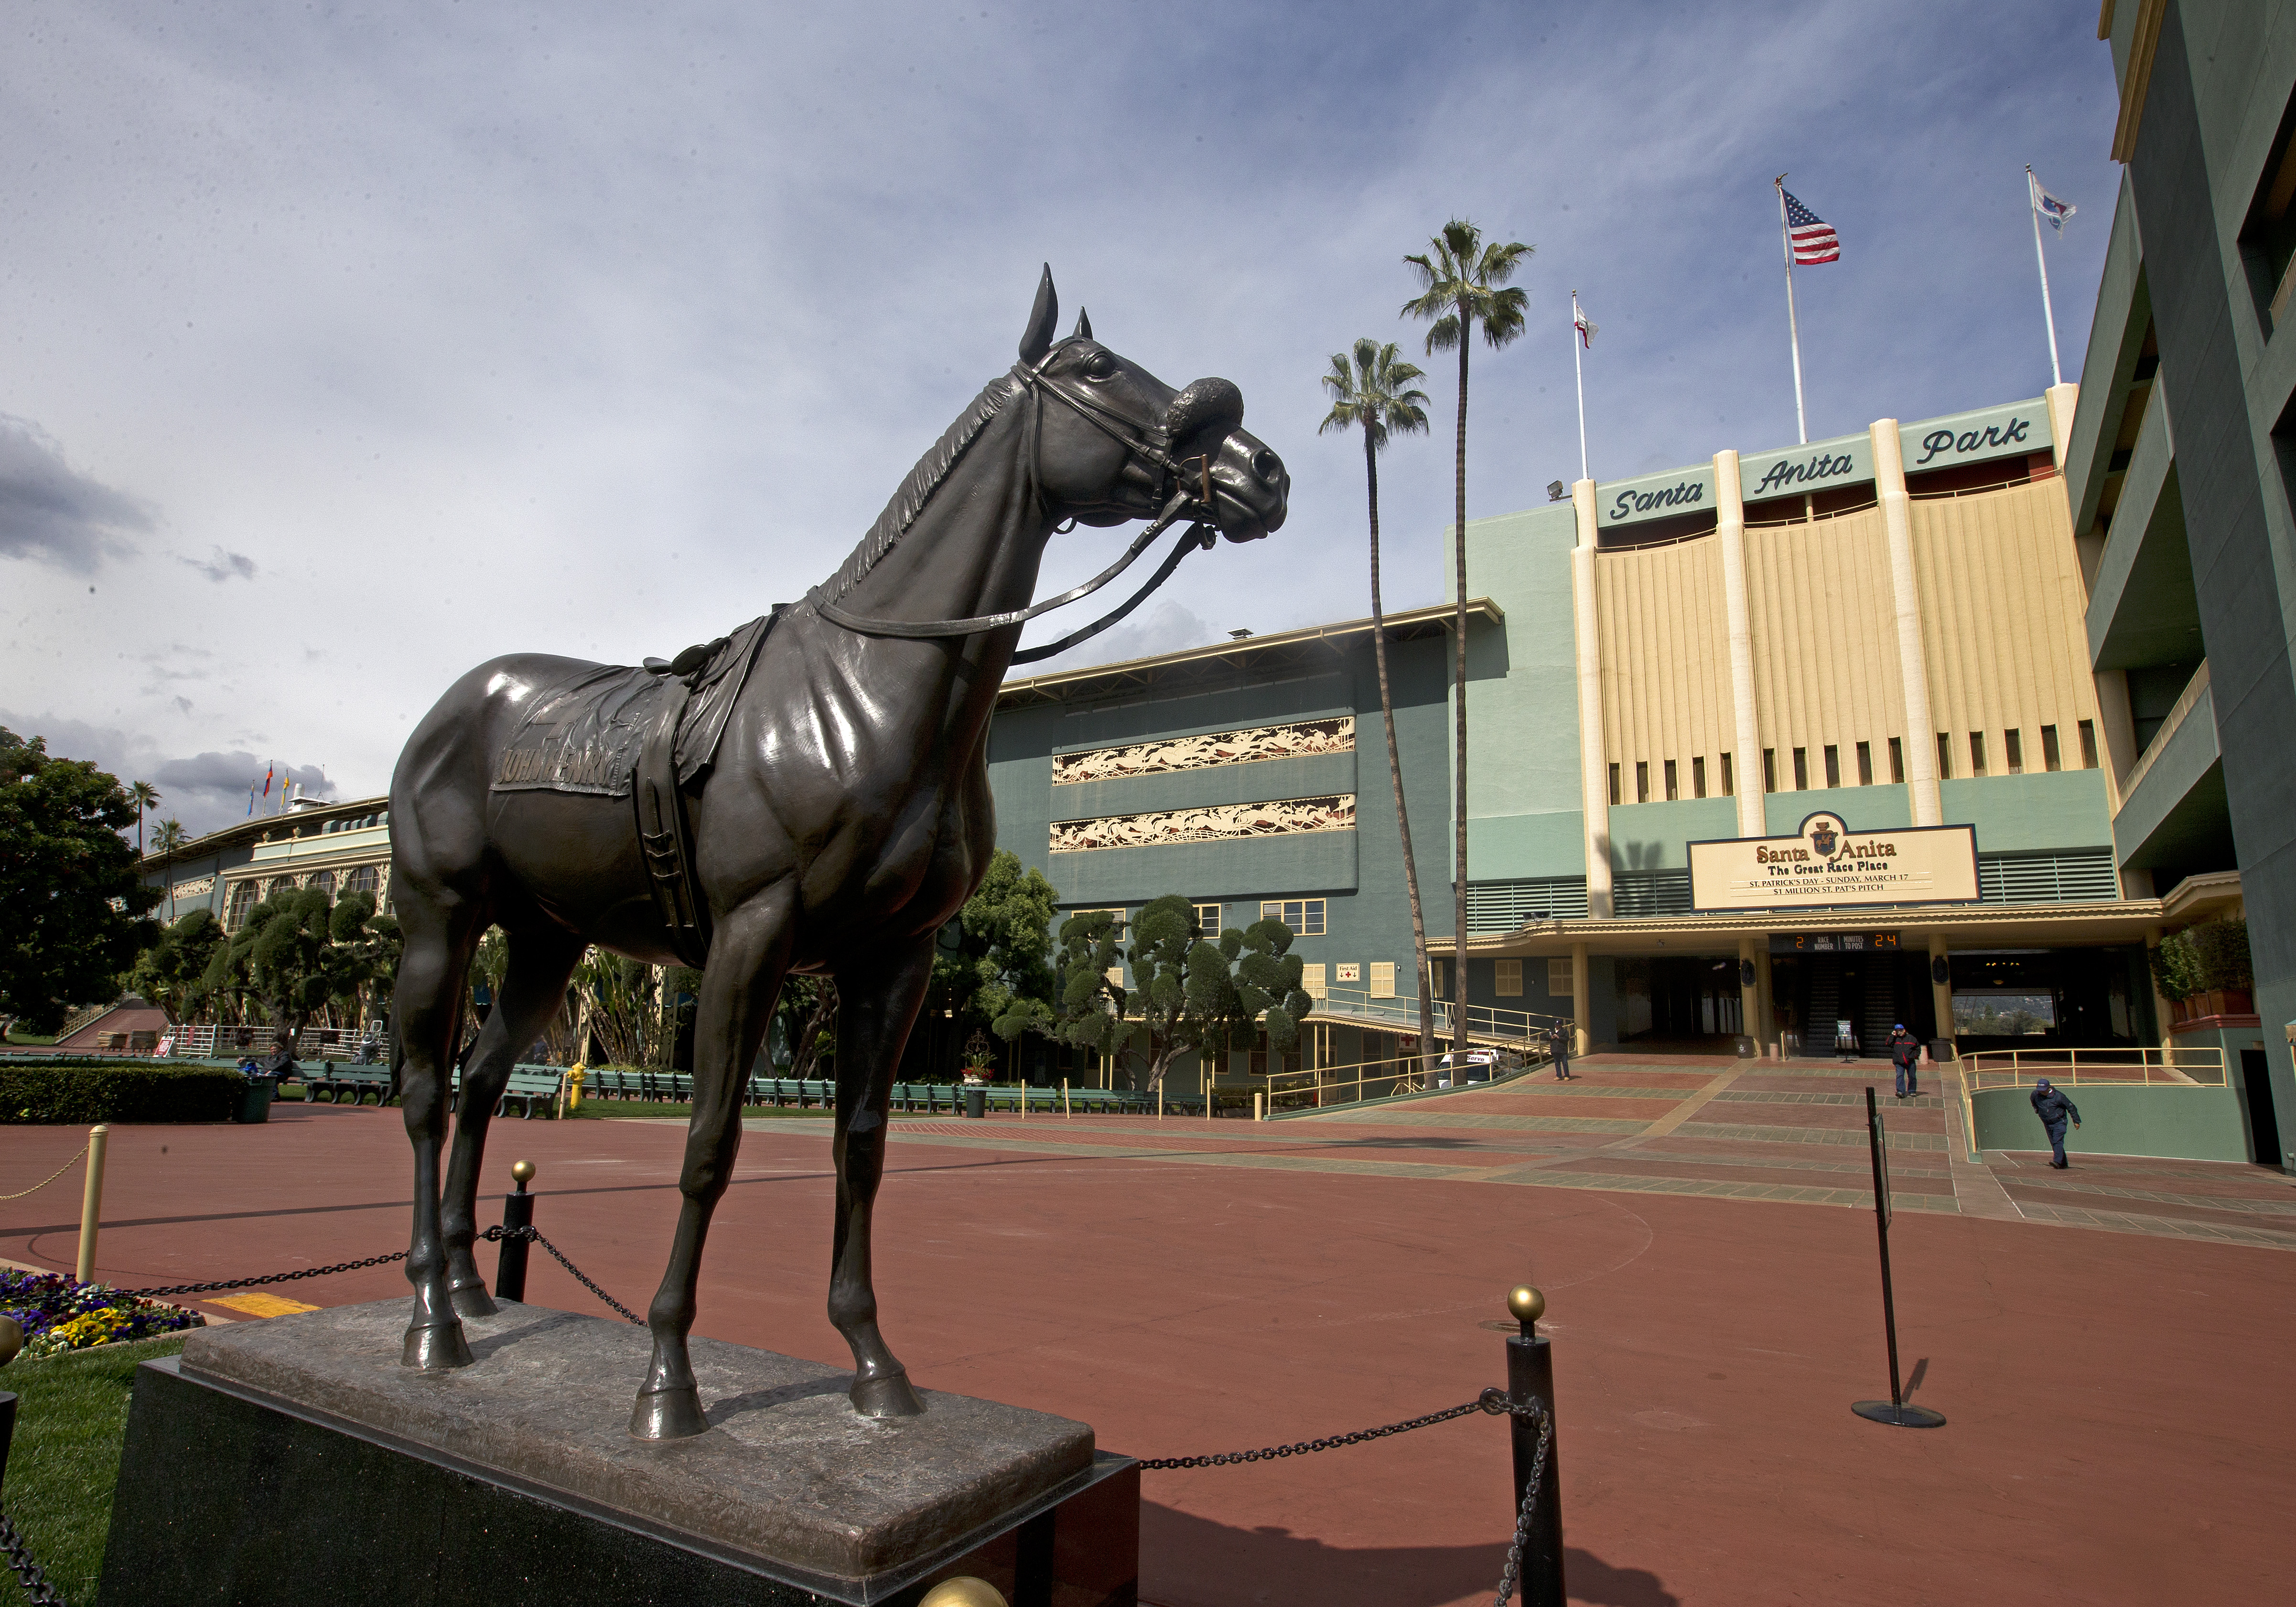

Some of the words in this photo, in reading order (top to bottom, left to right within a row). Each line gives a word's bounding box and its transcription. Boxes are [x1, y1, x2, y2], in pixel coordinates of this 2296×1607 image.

[1610, 482, 1703, 520] Santa
[1754, 454, 1853, 494] Anita
[1916, 417, 2029, 464] Park
[497, 748, 541, 785] JOHN
[542, 748, 615, 785] HENRY
[1756, 845, 1810, 864] Santa
[1829, 839, 1897, 863] Anita
[1768, 866, 1789, 876] The
[1794, 864, 1823, 874] Great
[1827, 862, 1853, 873] Race
[1857, 861, 1887, 871] Place
[1796, 936, 1803, 948] 2
